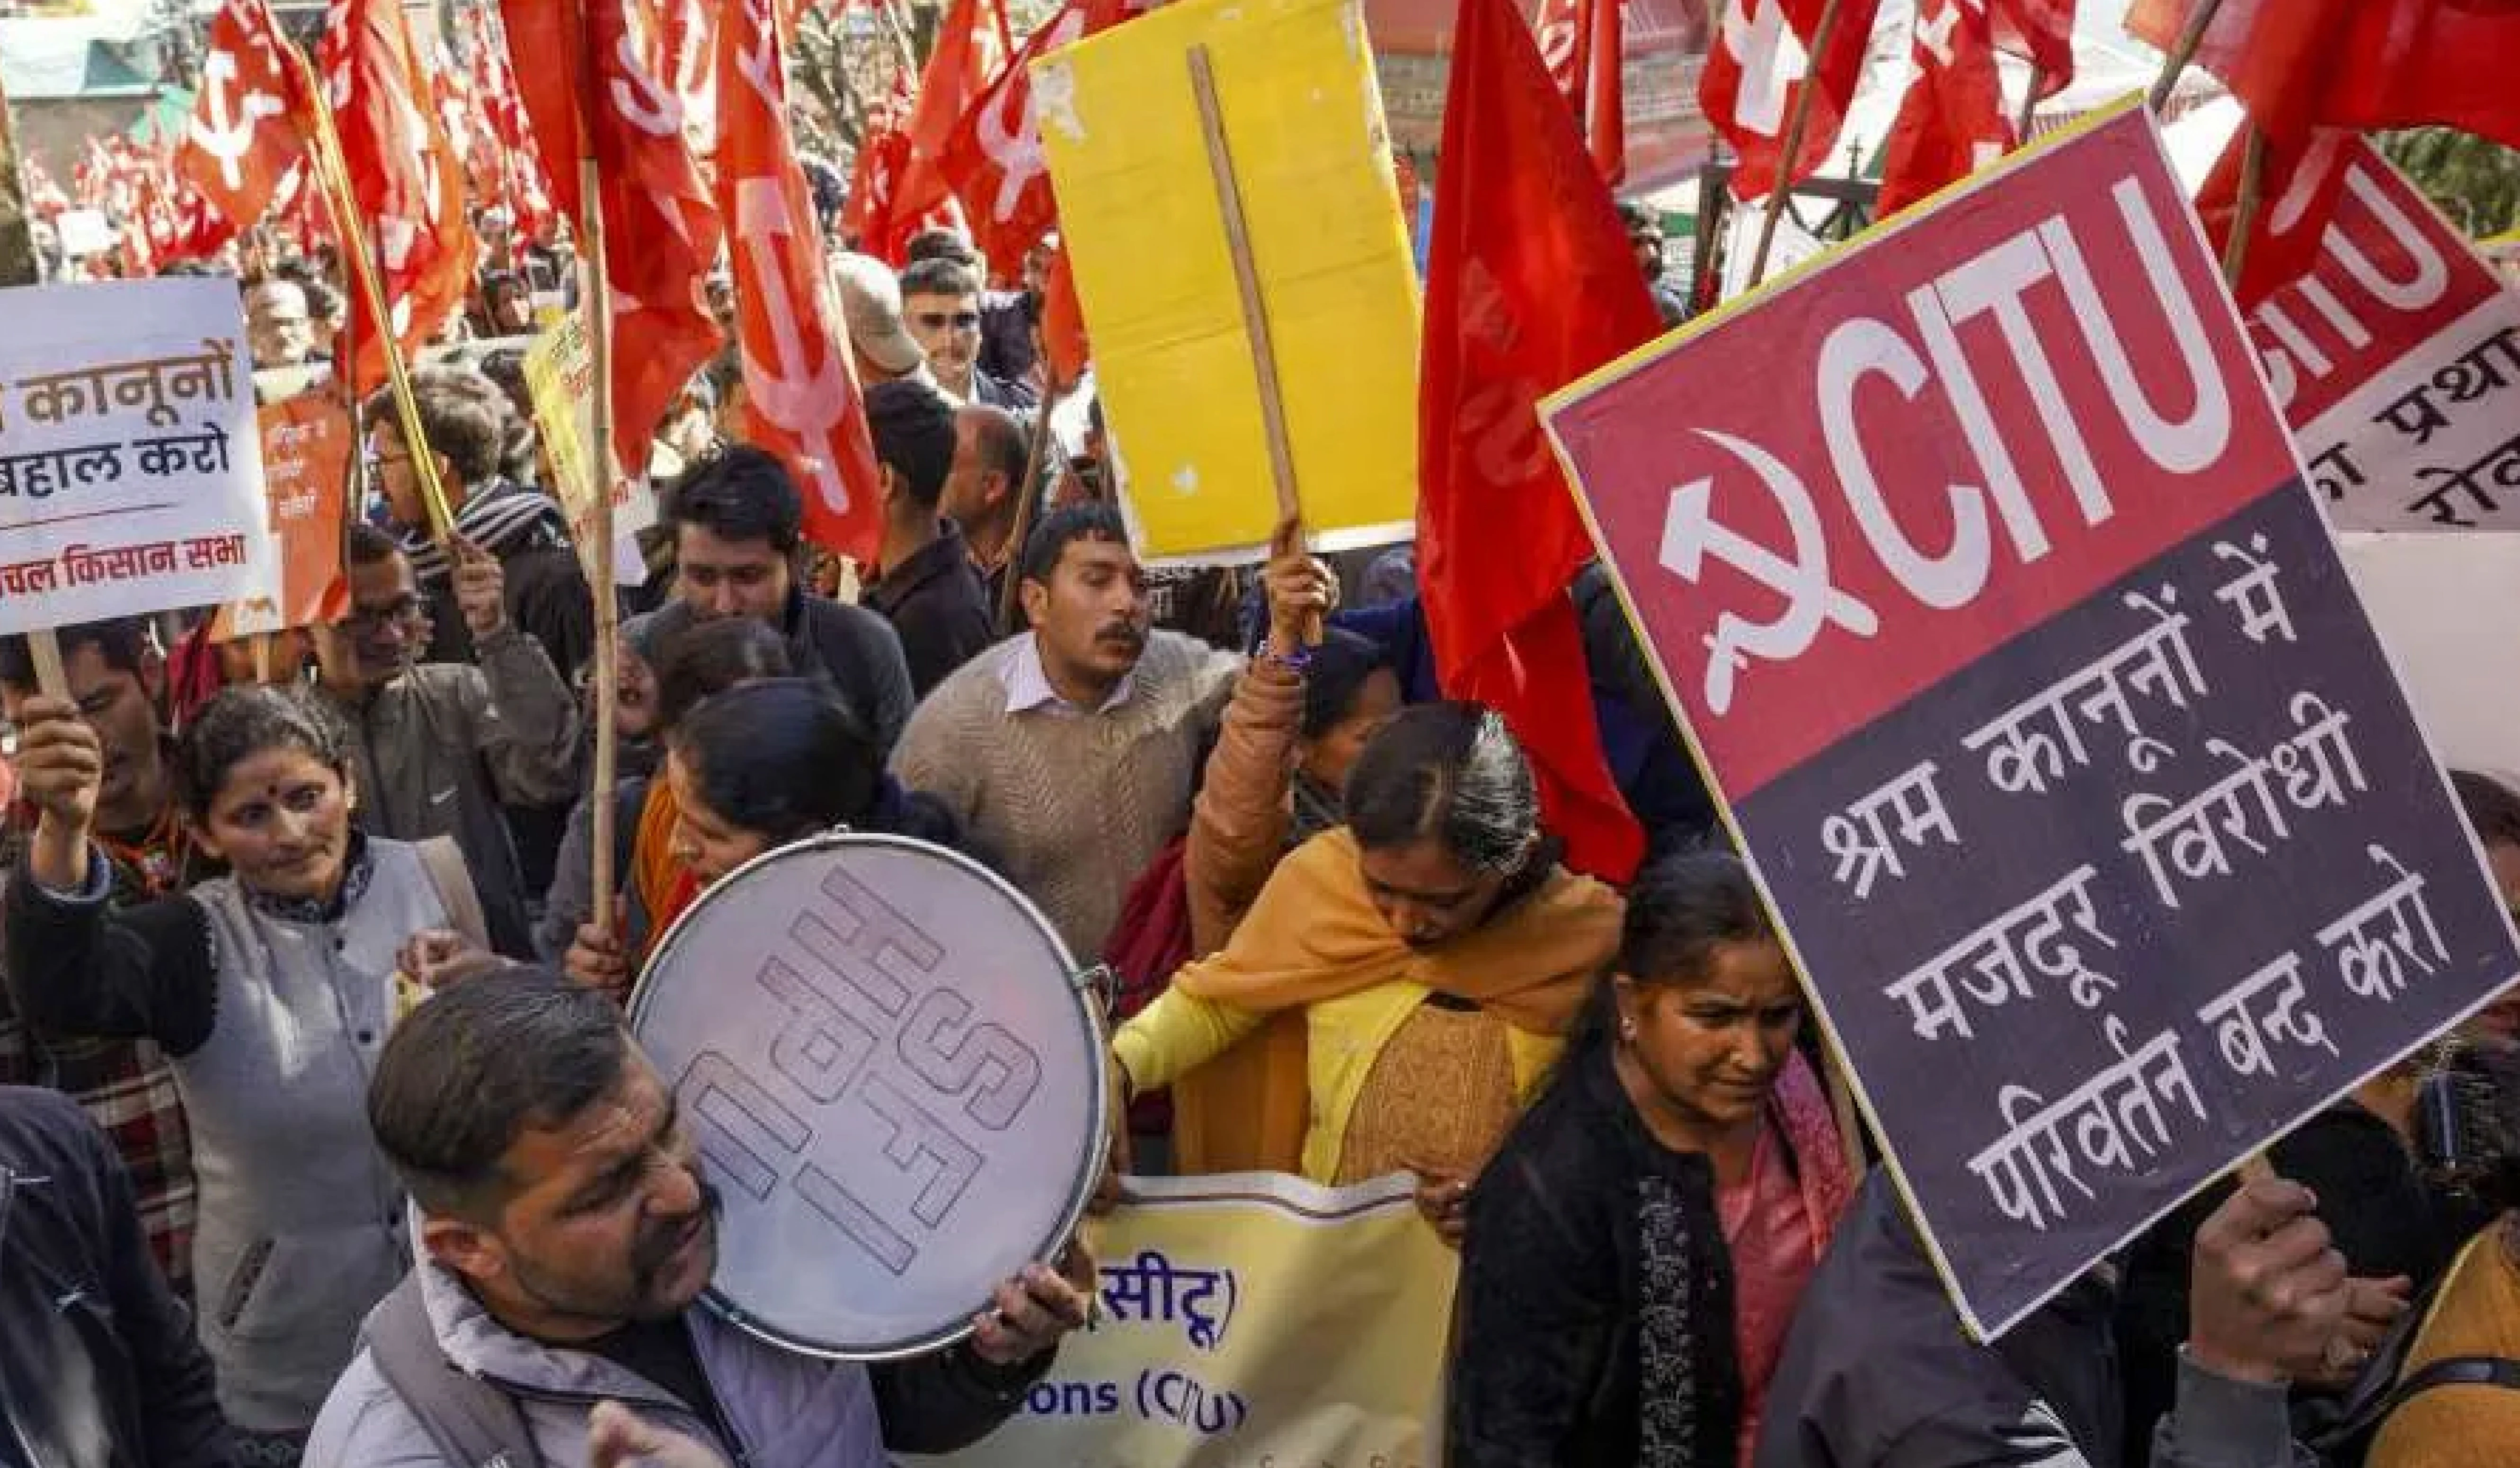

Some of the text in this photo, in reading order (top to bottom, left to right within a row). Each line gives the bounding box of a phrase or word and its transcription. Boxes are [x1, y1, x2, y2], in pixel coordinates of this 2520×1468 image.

[15, 337, 234, 427] कानूनों
[1817, 175, 2231, 609] CITU
[132, 421, 229, 475] करो
[0, 535, 246, 597] चल किसान सभा
[1820, 531, 2298, 899] श्रम कानूनों में
[1883, 690, 2367, 1041] मजदूर विरोधी
[1968, 845, 2451, 1232] परिवर्तन बन्द करो
[1090, 1249, 1237, 1352] सीटू)
[1025, 1381, 1120, 1415] ons
